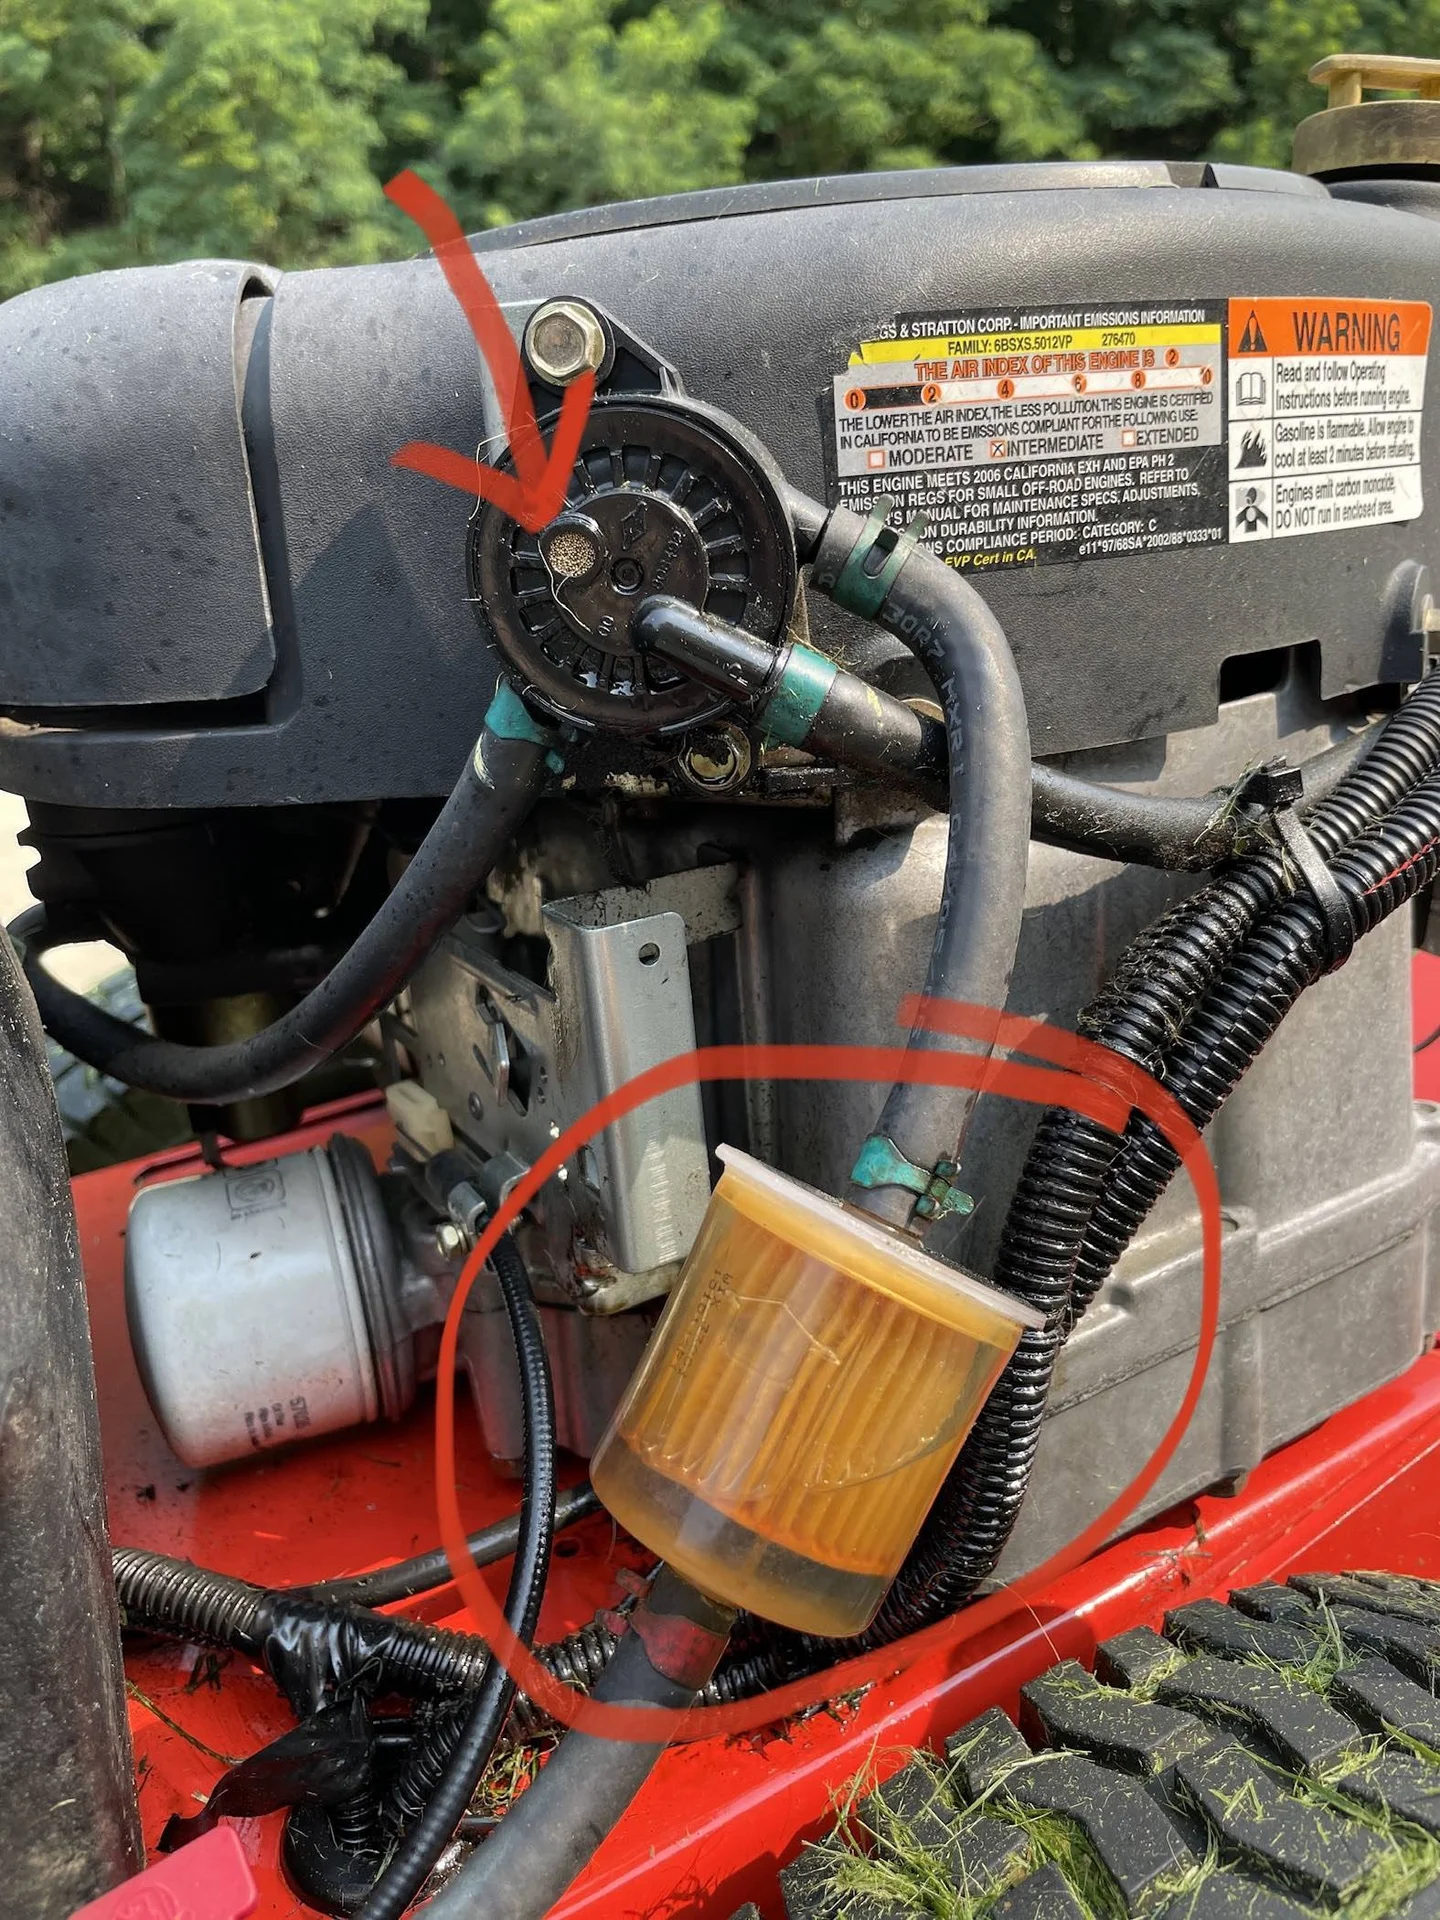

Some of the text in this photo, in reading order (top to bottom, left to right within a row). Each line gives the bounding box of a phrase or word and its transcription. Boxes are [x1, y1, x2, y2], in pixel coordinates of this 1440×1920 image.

[900, 323, 909, 338] &
[911, 319, 976, 337] STRATTON
[1020, 313, 1082, 330] IMPORTANT
[1084, 311, 1140, 327] EMISSIONS
[1140, 309, 1205, 324] INFORMATION
[1292, 311, 1400, 352] WARNING
[947, 332, 1136, 356] FAMILY: 6BSXS.5012VP 276470
[914, 348, 1176, 381] THE AIR INDEX OF THIS ENGINE IS 2
[1276, 360, 1386, 385] Read and follow Operating
[850, 392, 858, 409] 0
[927, 386, 937, 402] 2
[1001, 380, 1009, 398] 4
[1276, 385, 1411, 410] Instructions before running engine.
[840, 417, 863, 432] THE
[935, 409, 954, 424] AIR
[956, 407, 991, 421] INDEX,
[991, 406, 1012, 419] THE
[1015, 403, 1041, 417] LESS
[1100, 398, 1122, 411] THIS
[1124, 395, 1158, 409] ENGINE
[1160, 394, 1168, 407] IS
[1169, 392, 1213, 406] CERTIFIED
[840, 436, 852, 449] IN
[854, 430, 925, 448] CALIFORNIA
[925, 429, 940, 442] TO
[943, 427, 959, 441] BE
[961, 421, 1020, 439] EMISSIONS
[1021, 417, 1080, 434] COMPLIANT
[1082, 416, 1101, 430] FOR
[1101, 415, 1121, 428] THE
[1123, 411, 1177, 427] FOLLOWING
[1275, 421, 1316, 442] Gasoline
[1368, 417, 1386, 436] Allow
[1387, 416, 1407, 439] engine
[1407, 416, 1414, 433] to
[889, 426, 1199, 467] MODERATE INTERMEDIATE EXTENDED
[1275, 447, 1295, 468] cool
[1297, 447, 1306, 467] at
[1308, 446, 1328, 465] least
[1329, 445, 1335, 463] 2
[1336, 443, 1364, 463] minutes
[1366, 441, 1386, 460] before
[838, 453, 1175, 496] THIS ENGINE MEETS 2006 CALIFORNIA EXH AND EPA PH 2
[840, 467, 1189, 512] EMISSN REGS FOR SMALL OFF-ROAD ENGINES. REFER TO
[1276, 482, 1313, 507] Engines
[1315, 478, 1333, 499] emit
[1335, 477, 1361, 497] carbon
[906, 506, 960, 524] MNUAL
[964, 503, 990, 518] FOR
[993, 495, 1078, 515] MAINTENANCE
[941, 517, 1015, 537] DURABILITY
[1017, 509, 1098, 530] INFORMATION.
[1276, 498, 1394, 529] DO NOT run in enclosed area.
[946, 532, 1027, 552] COMPLIANCE
[1030, 527, 1077, 544] PERIOD:
[1082, 520, 1144, 539] CATEGORY:
[1148, 518, 1157, 532] C
[973, 551, 1000, 566] Cert
[1002, 551, 1013, 562] in
[1016, 548, 1037, 561] CA.
